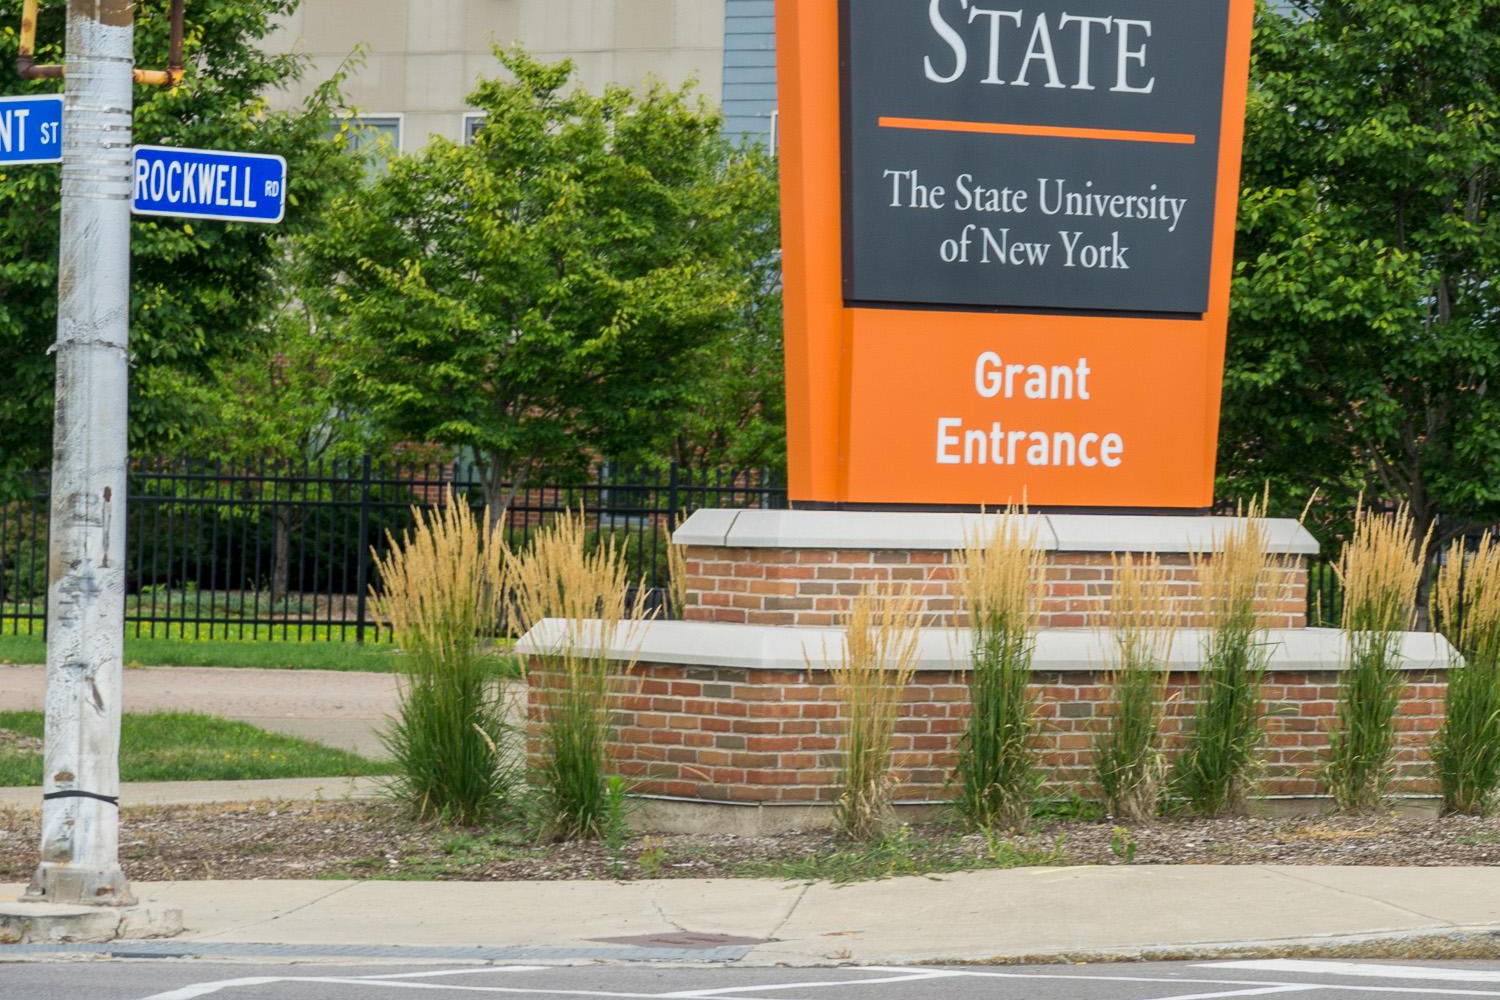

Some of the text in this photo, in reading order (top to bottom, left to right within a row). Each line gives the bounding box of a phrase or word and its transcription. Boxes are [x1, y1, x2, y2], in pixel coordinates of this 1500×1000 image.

[40, 121, 59, 145] ST
[135, 158, 280, 208] ROCKWELL RD
[883, 169, 1188, 233] The State University
[939, 223, 1130, 270] of New York
[974, 350, 1091, 401] Grant
[936, 417, 1124, 468] Entrance
